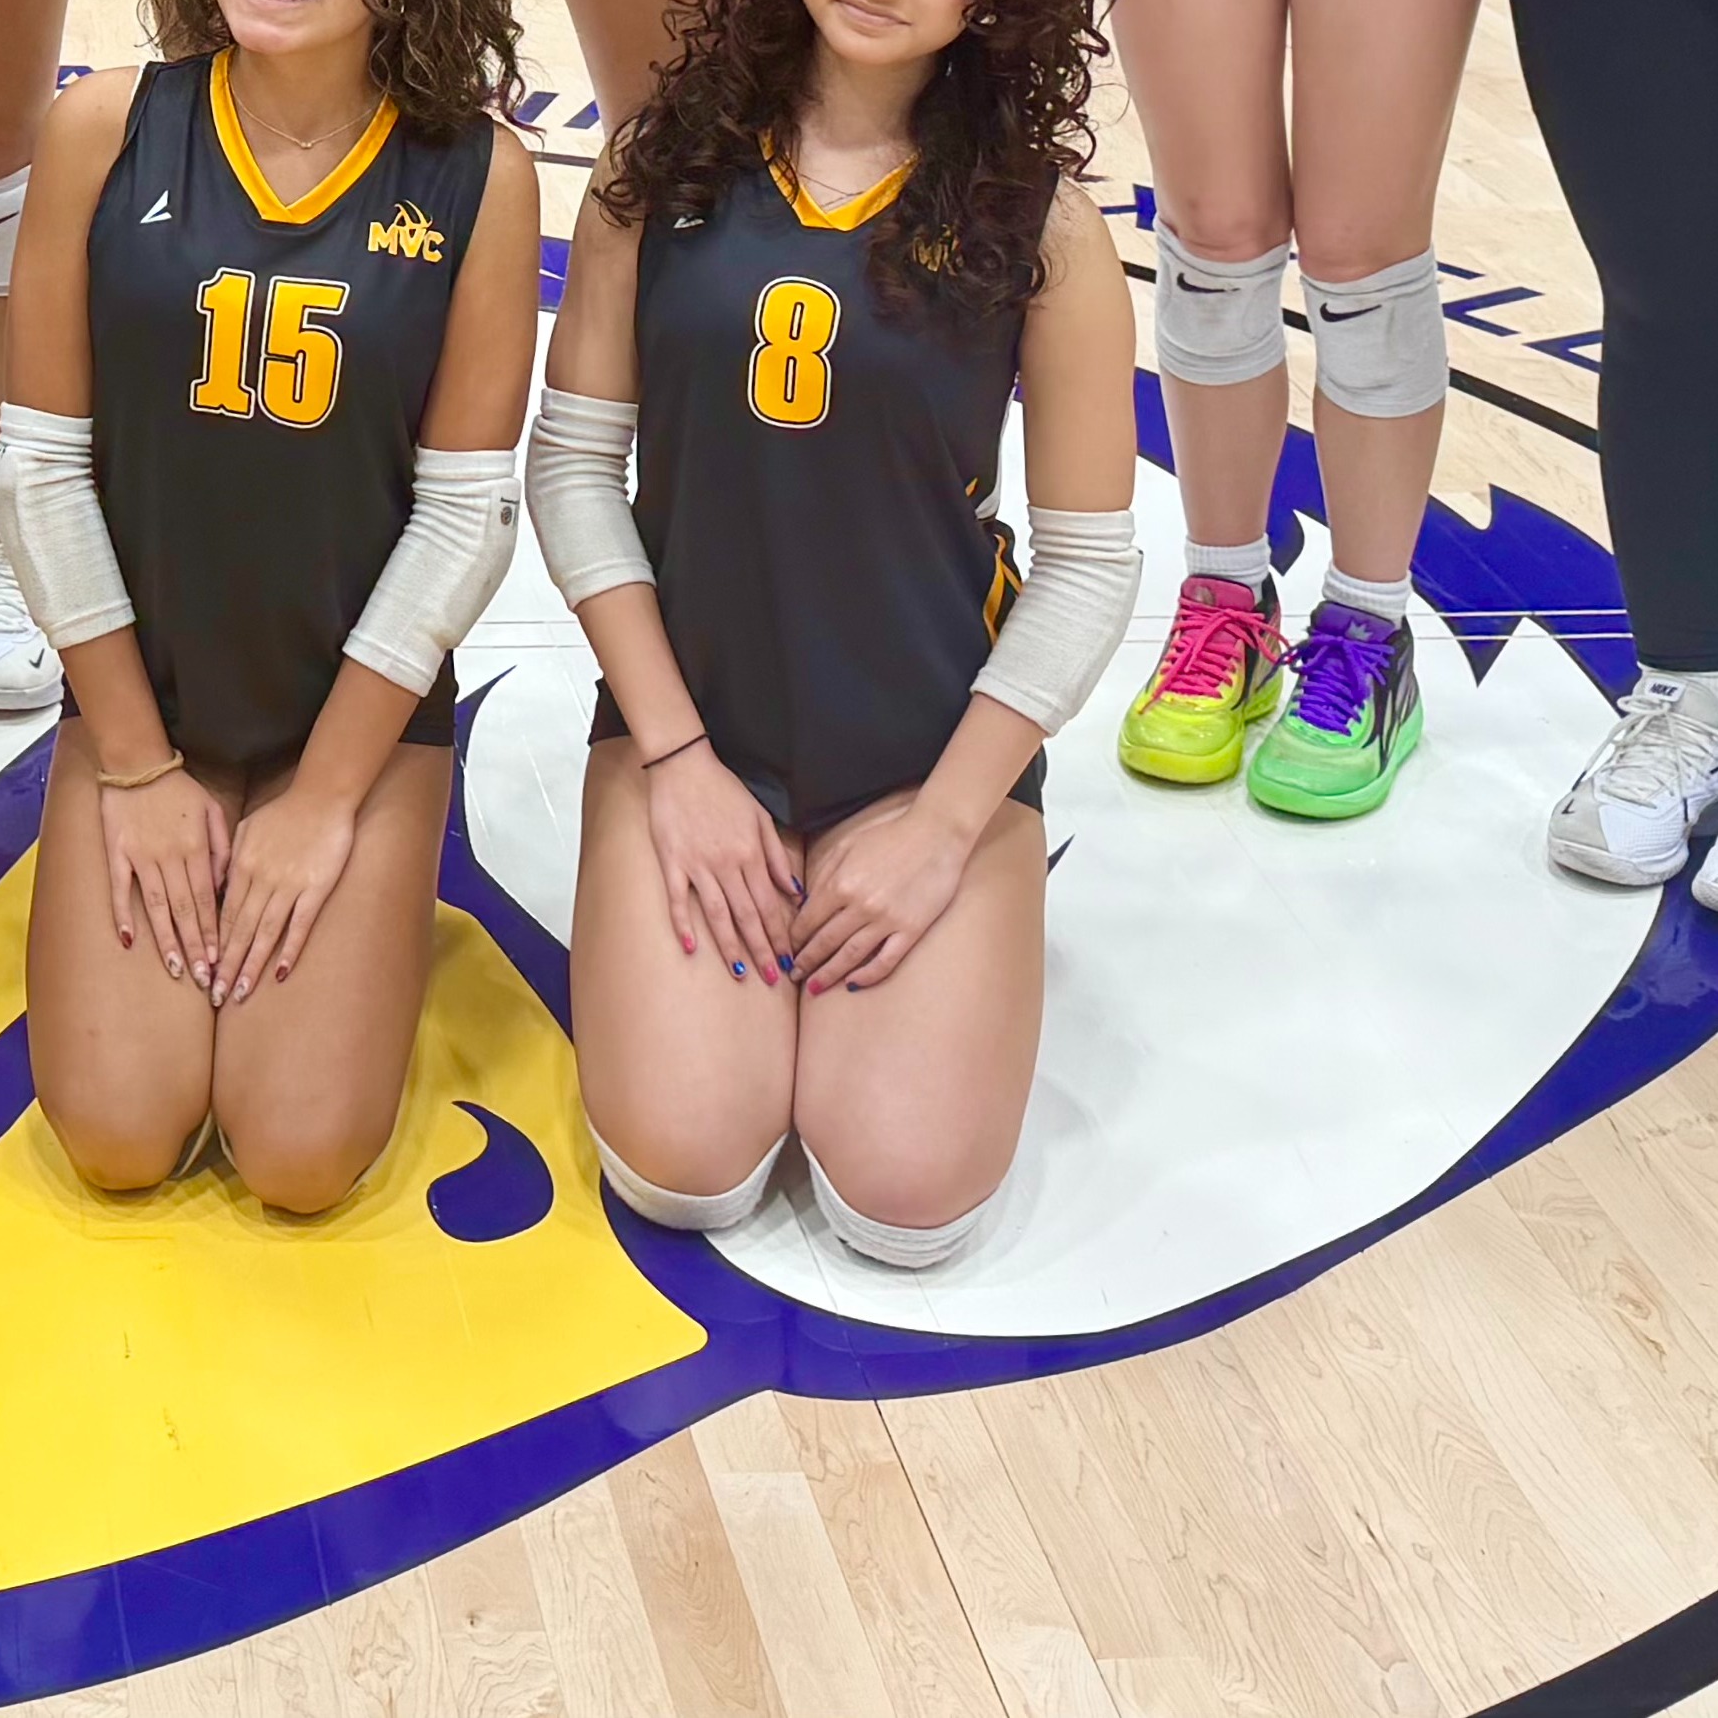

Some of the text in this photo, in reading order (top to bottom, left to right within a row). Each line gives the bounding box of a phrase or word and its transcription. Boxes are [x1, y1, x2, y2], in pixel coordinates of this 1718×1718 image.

[368, 221, 445, 263] MVC
[189, 266, 351, 430] 15
[747, 275, 842, 429] 8
[1650, 683, 1678, 697] NIKE
